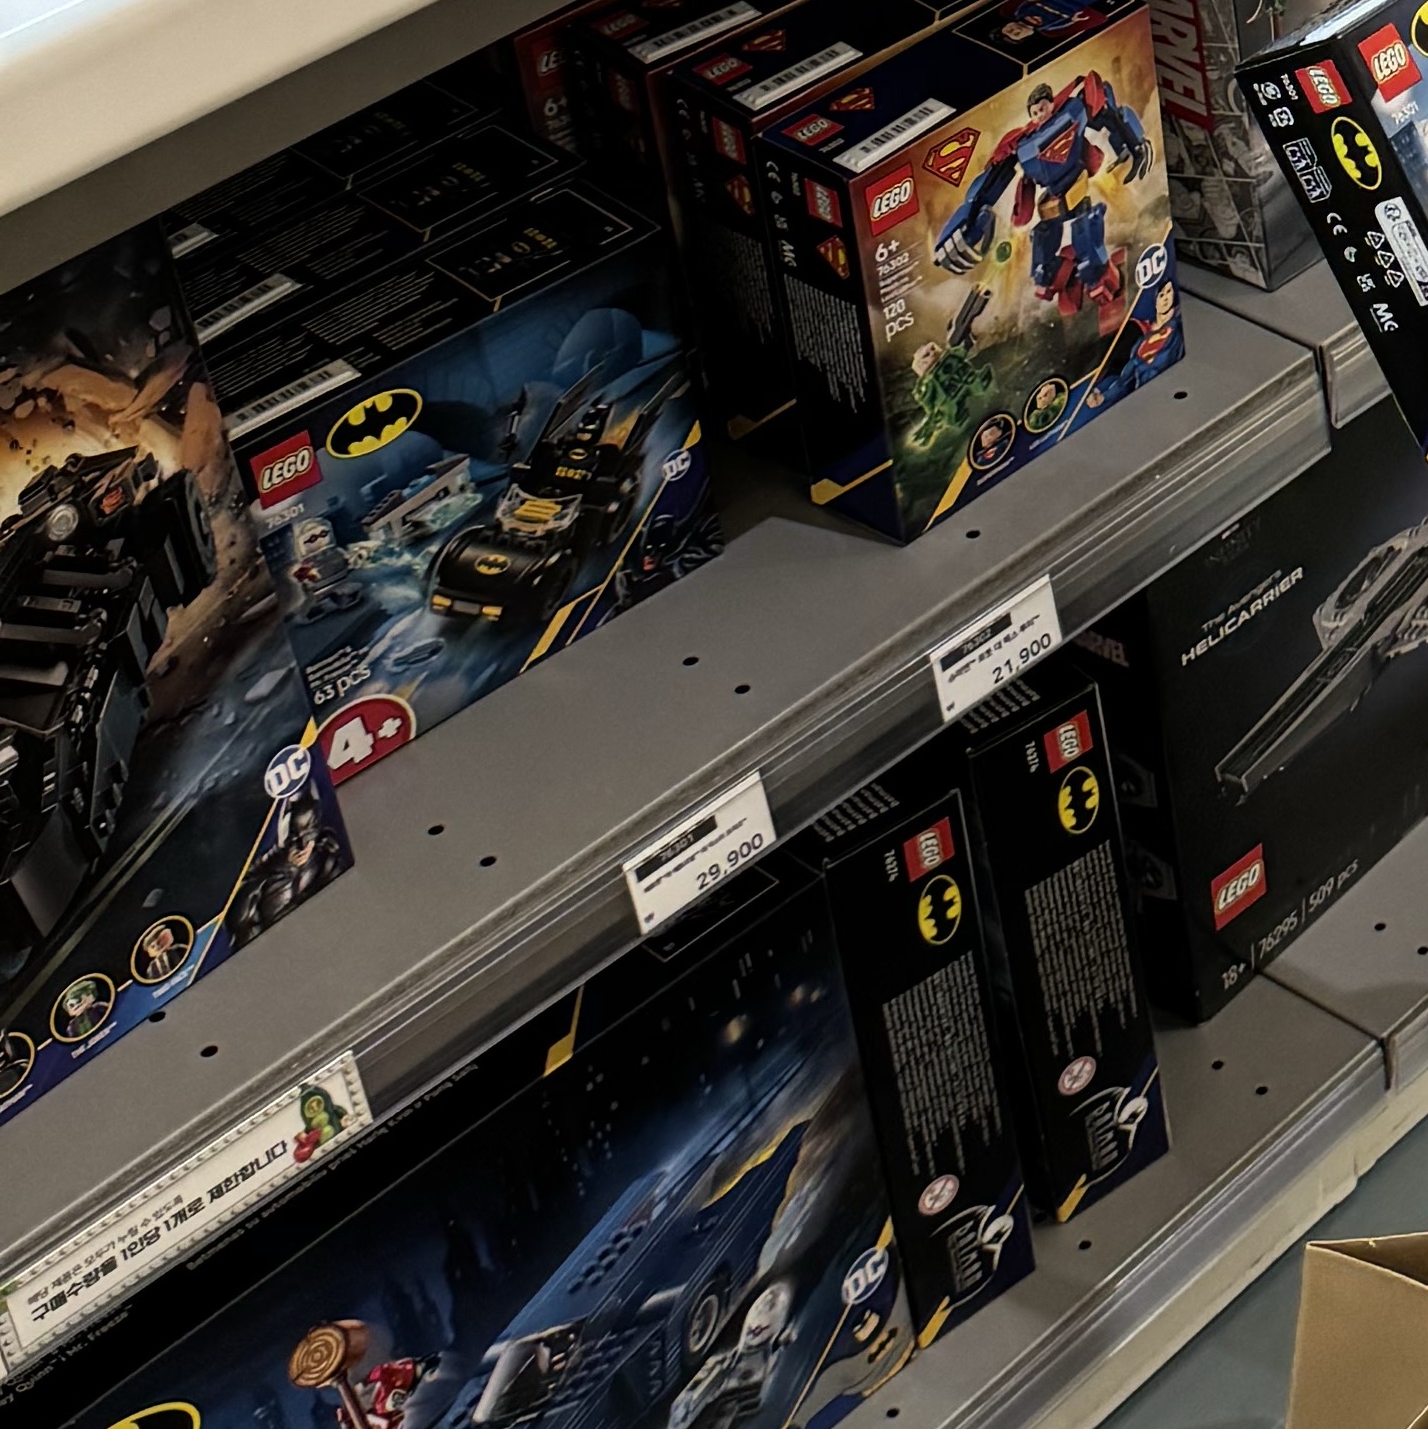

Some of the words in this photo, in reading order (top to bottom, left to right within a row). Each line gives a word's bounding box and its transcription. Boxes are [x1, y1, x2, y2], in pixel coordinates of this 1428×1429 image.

[1371, 42, 1408, 82] LEGO
[1307, 65, 1341, 108] LEGO
[797, 119, 831, 140] LEGO
[871, 178, 913, 221] LEGO
[874, 239, 900, 263] 6+
[877, 252, 911, 276] 76302
[1137, 247, 1166, 286] DC
[882, 298, 906, 320] 120
[884, 312, 915, 343] pcs
[259, 445, 313, 492] LEGO
[662, 450, 691, 478] DC
[266, 502, 305, 529] 76301
[1180, 566, 1304, 667] HELICARRIER
[991, 632, 1052, 685] 21,900
[313, 684, 336, 705] 63
[335, 663, 372, 697] pcs
[327, 715, 404, 772] 4+
[1057, 722, 1080, 760] LEGO
[267, 749, 311, 792] DC
[696, 832, 764, 891] 29,900
[916, 829, 939, 870] LEGO
[1217, 862, 1262, 911] LEGO
[1221, 962, 1247, 990] 18+
[1257, 908, 1300, 960] 76295
[1308, 876, 1335, 914] 509
[1336, 858, 1359, 890] pcs
[30, 1255, 119, 1322] 구매수량을
[120, 1228, 163, 1261] 1인당
[161, 1196, 207, 1233] 1개로
[206, 1139, 289, 1205] 제한합니다
[843, 1252, 888, 1300] DC
